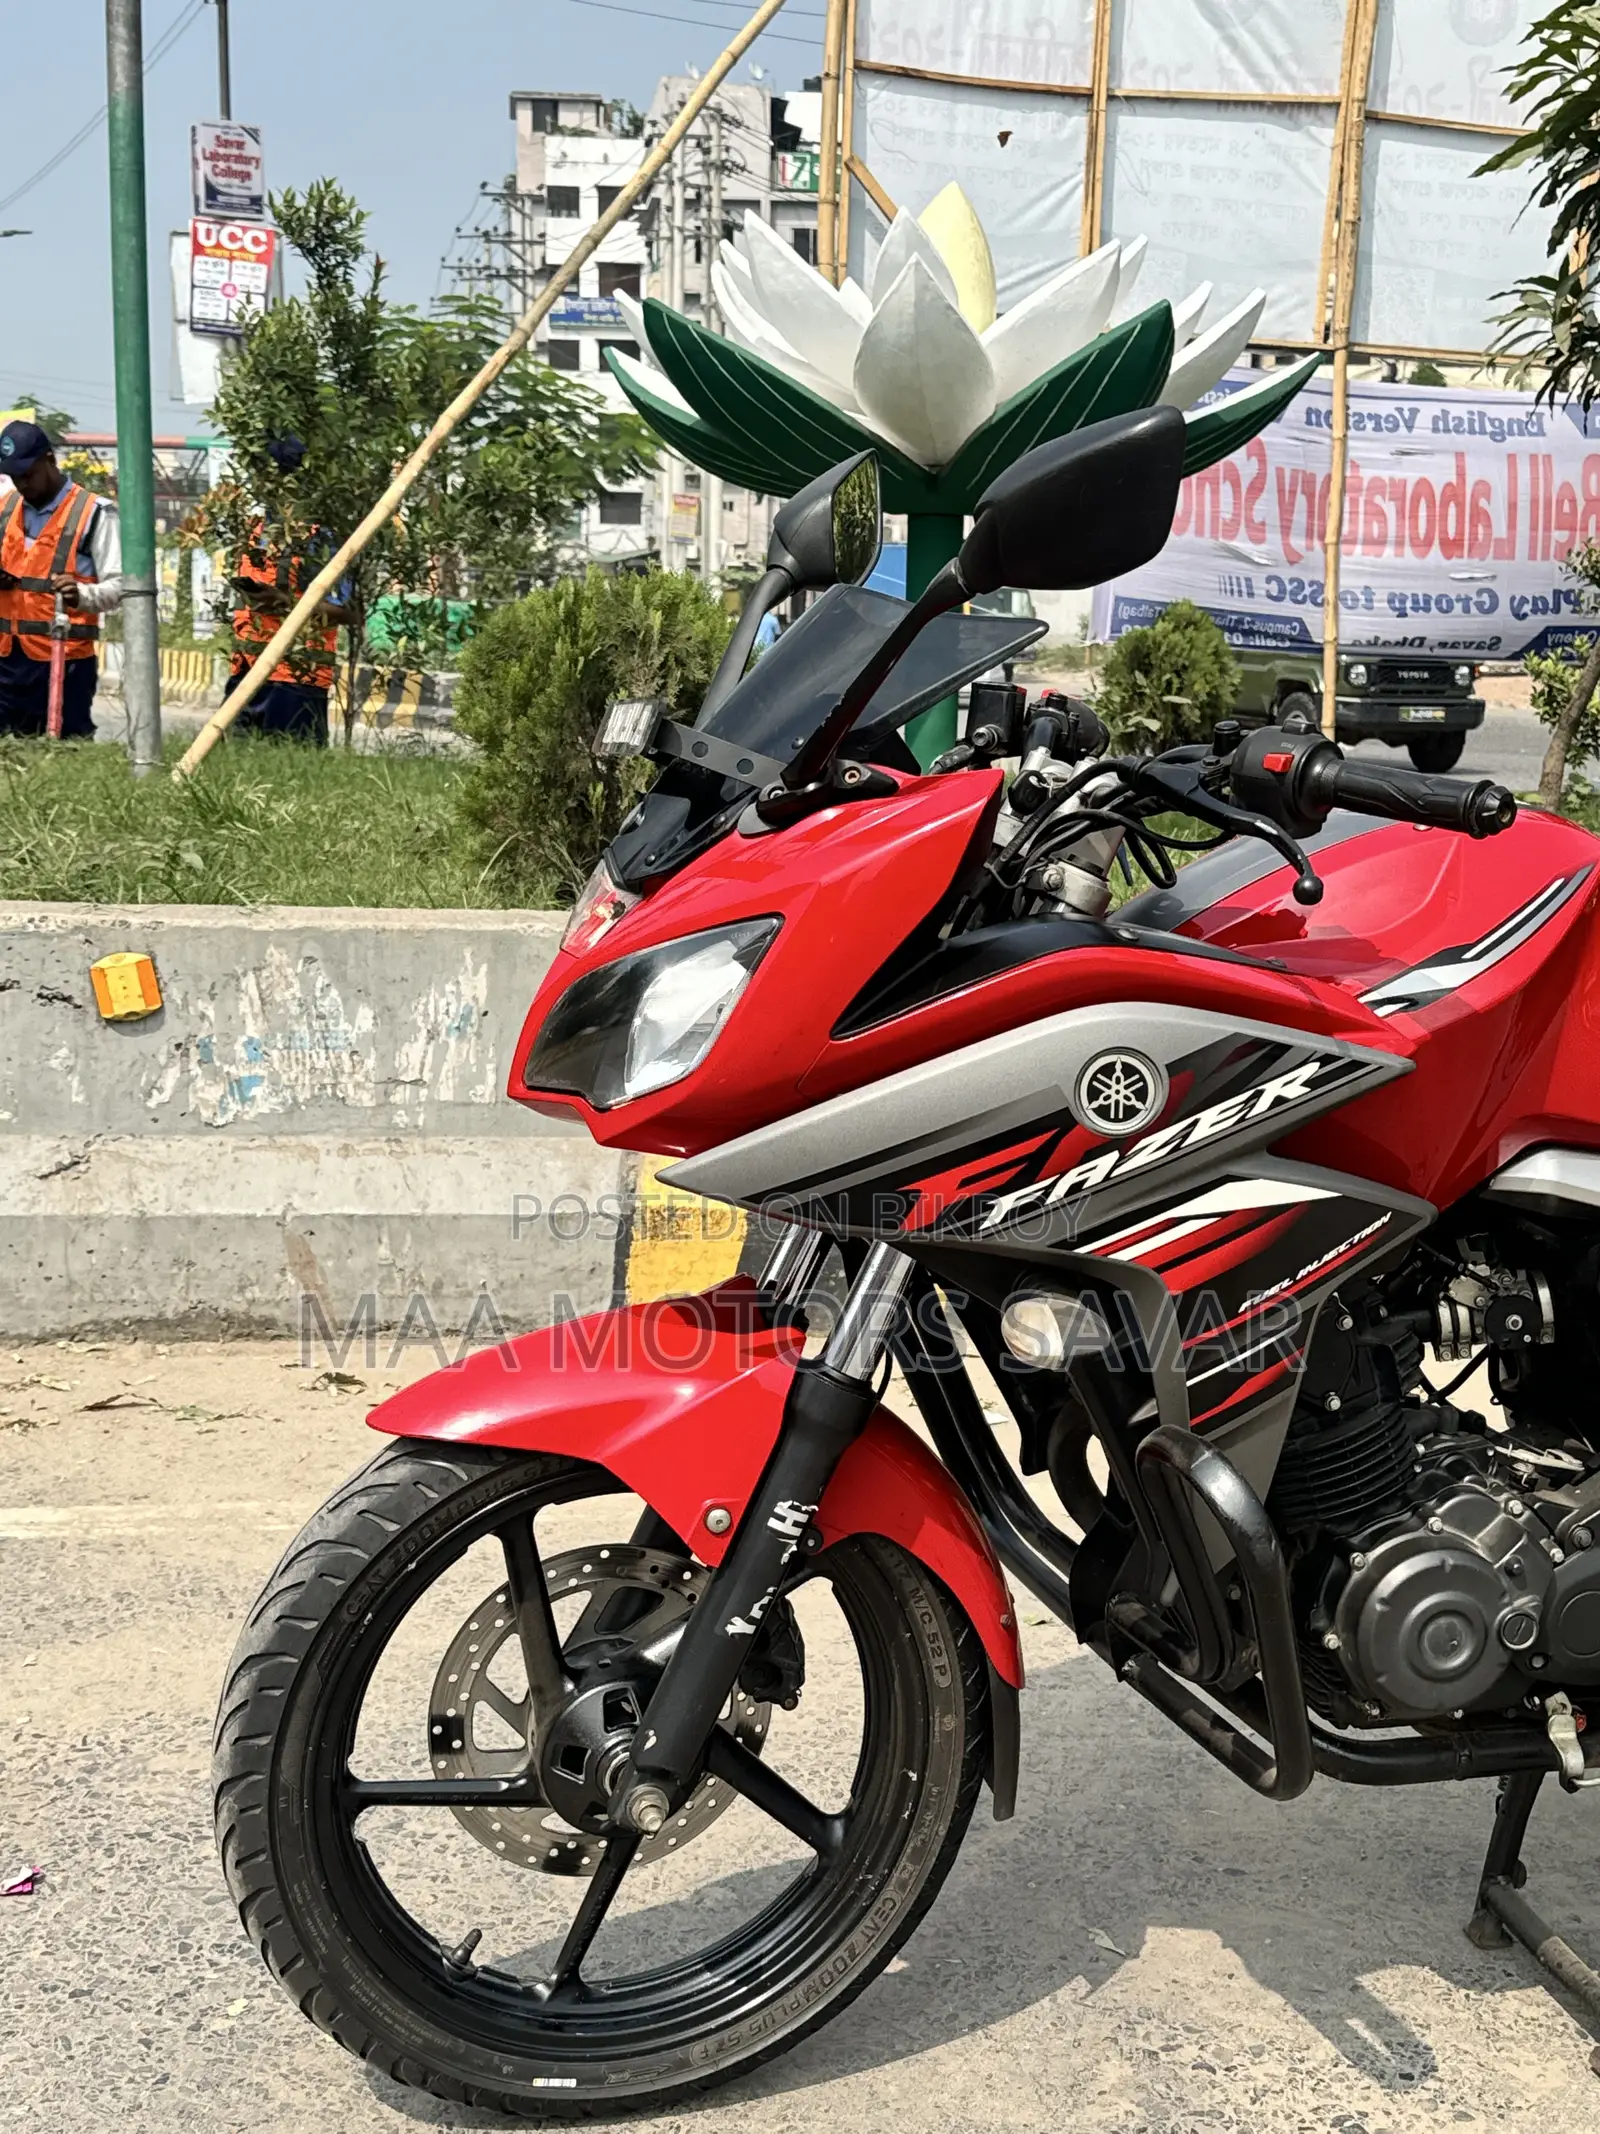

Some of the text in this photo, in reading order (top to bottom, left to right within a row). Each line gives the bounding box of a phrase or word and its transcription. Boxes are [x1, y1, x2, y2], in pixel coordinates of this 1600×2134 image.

[194, 221, 268, 254] UCC
[978, 1061, 1321, 1231] FAZER
[1238, 1211, 1392, 1314] FUEL INJECTION
[860, 1897, 898, 1945] CEAT
